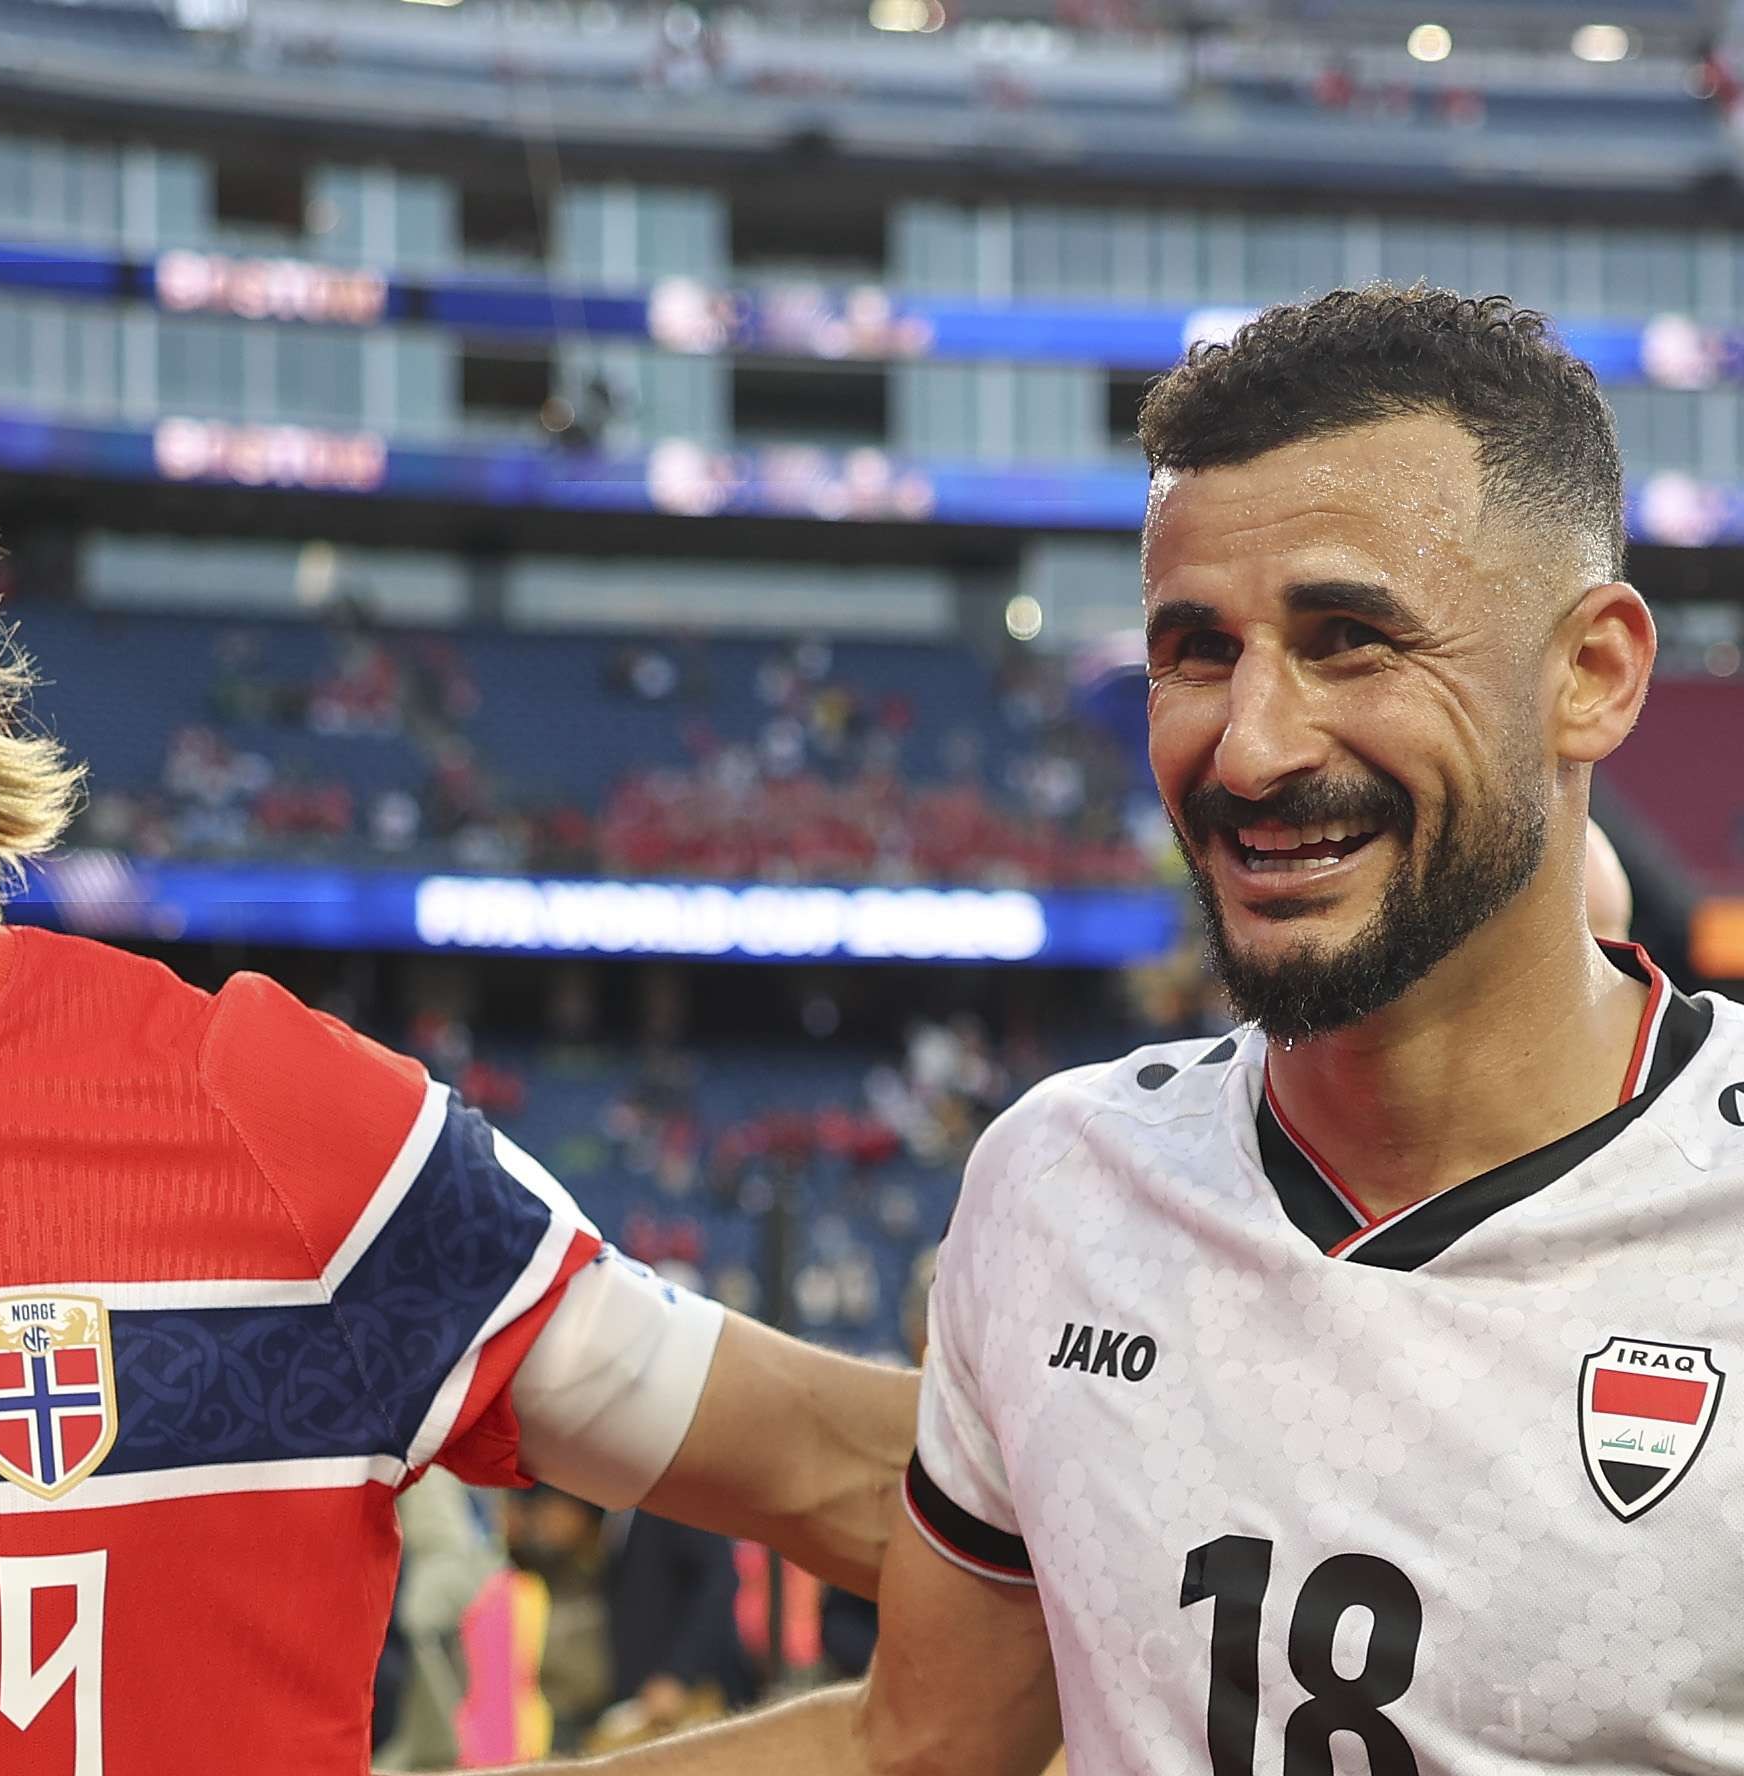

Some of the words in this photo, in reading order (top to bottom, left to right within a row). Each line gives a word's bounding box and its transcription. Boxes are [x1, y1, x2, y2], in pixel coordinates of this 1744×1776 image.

[11, 1303, 57, 1322] NORGE
[1048, 1322, 1158, 1383] JAKO
[1616, 1348, 1696, 1374] IRAQ
